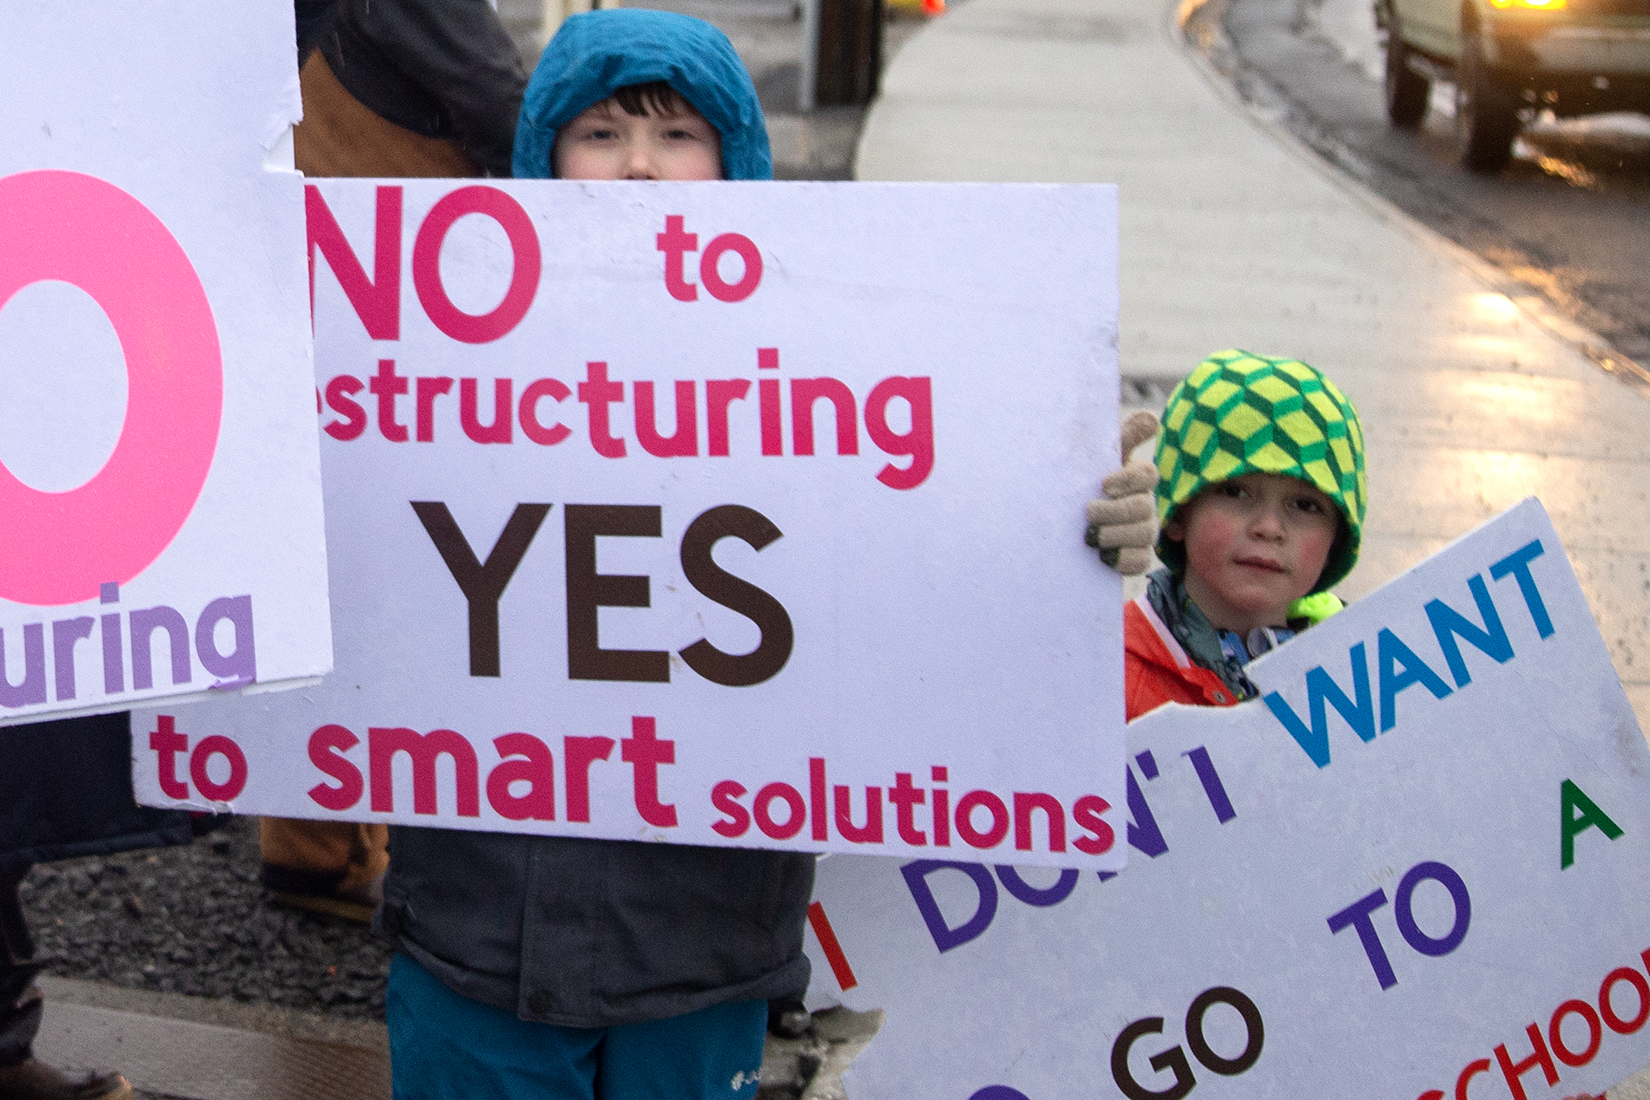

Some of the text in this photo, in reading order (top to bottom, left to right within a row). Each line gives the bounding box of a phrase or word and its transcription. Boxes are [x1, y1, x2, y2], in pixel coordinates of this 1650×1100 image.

[304, 183, 764, 345] NO to
[315, 347, 936, 490] structuring
[408, 500, 795, 688] YES
[1261, 537, 1557, 770] WANT
[149, 714, 1117, 856] to smart solutions
[1110, 778, 1626, 1100] GO TO A
